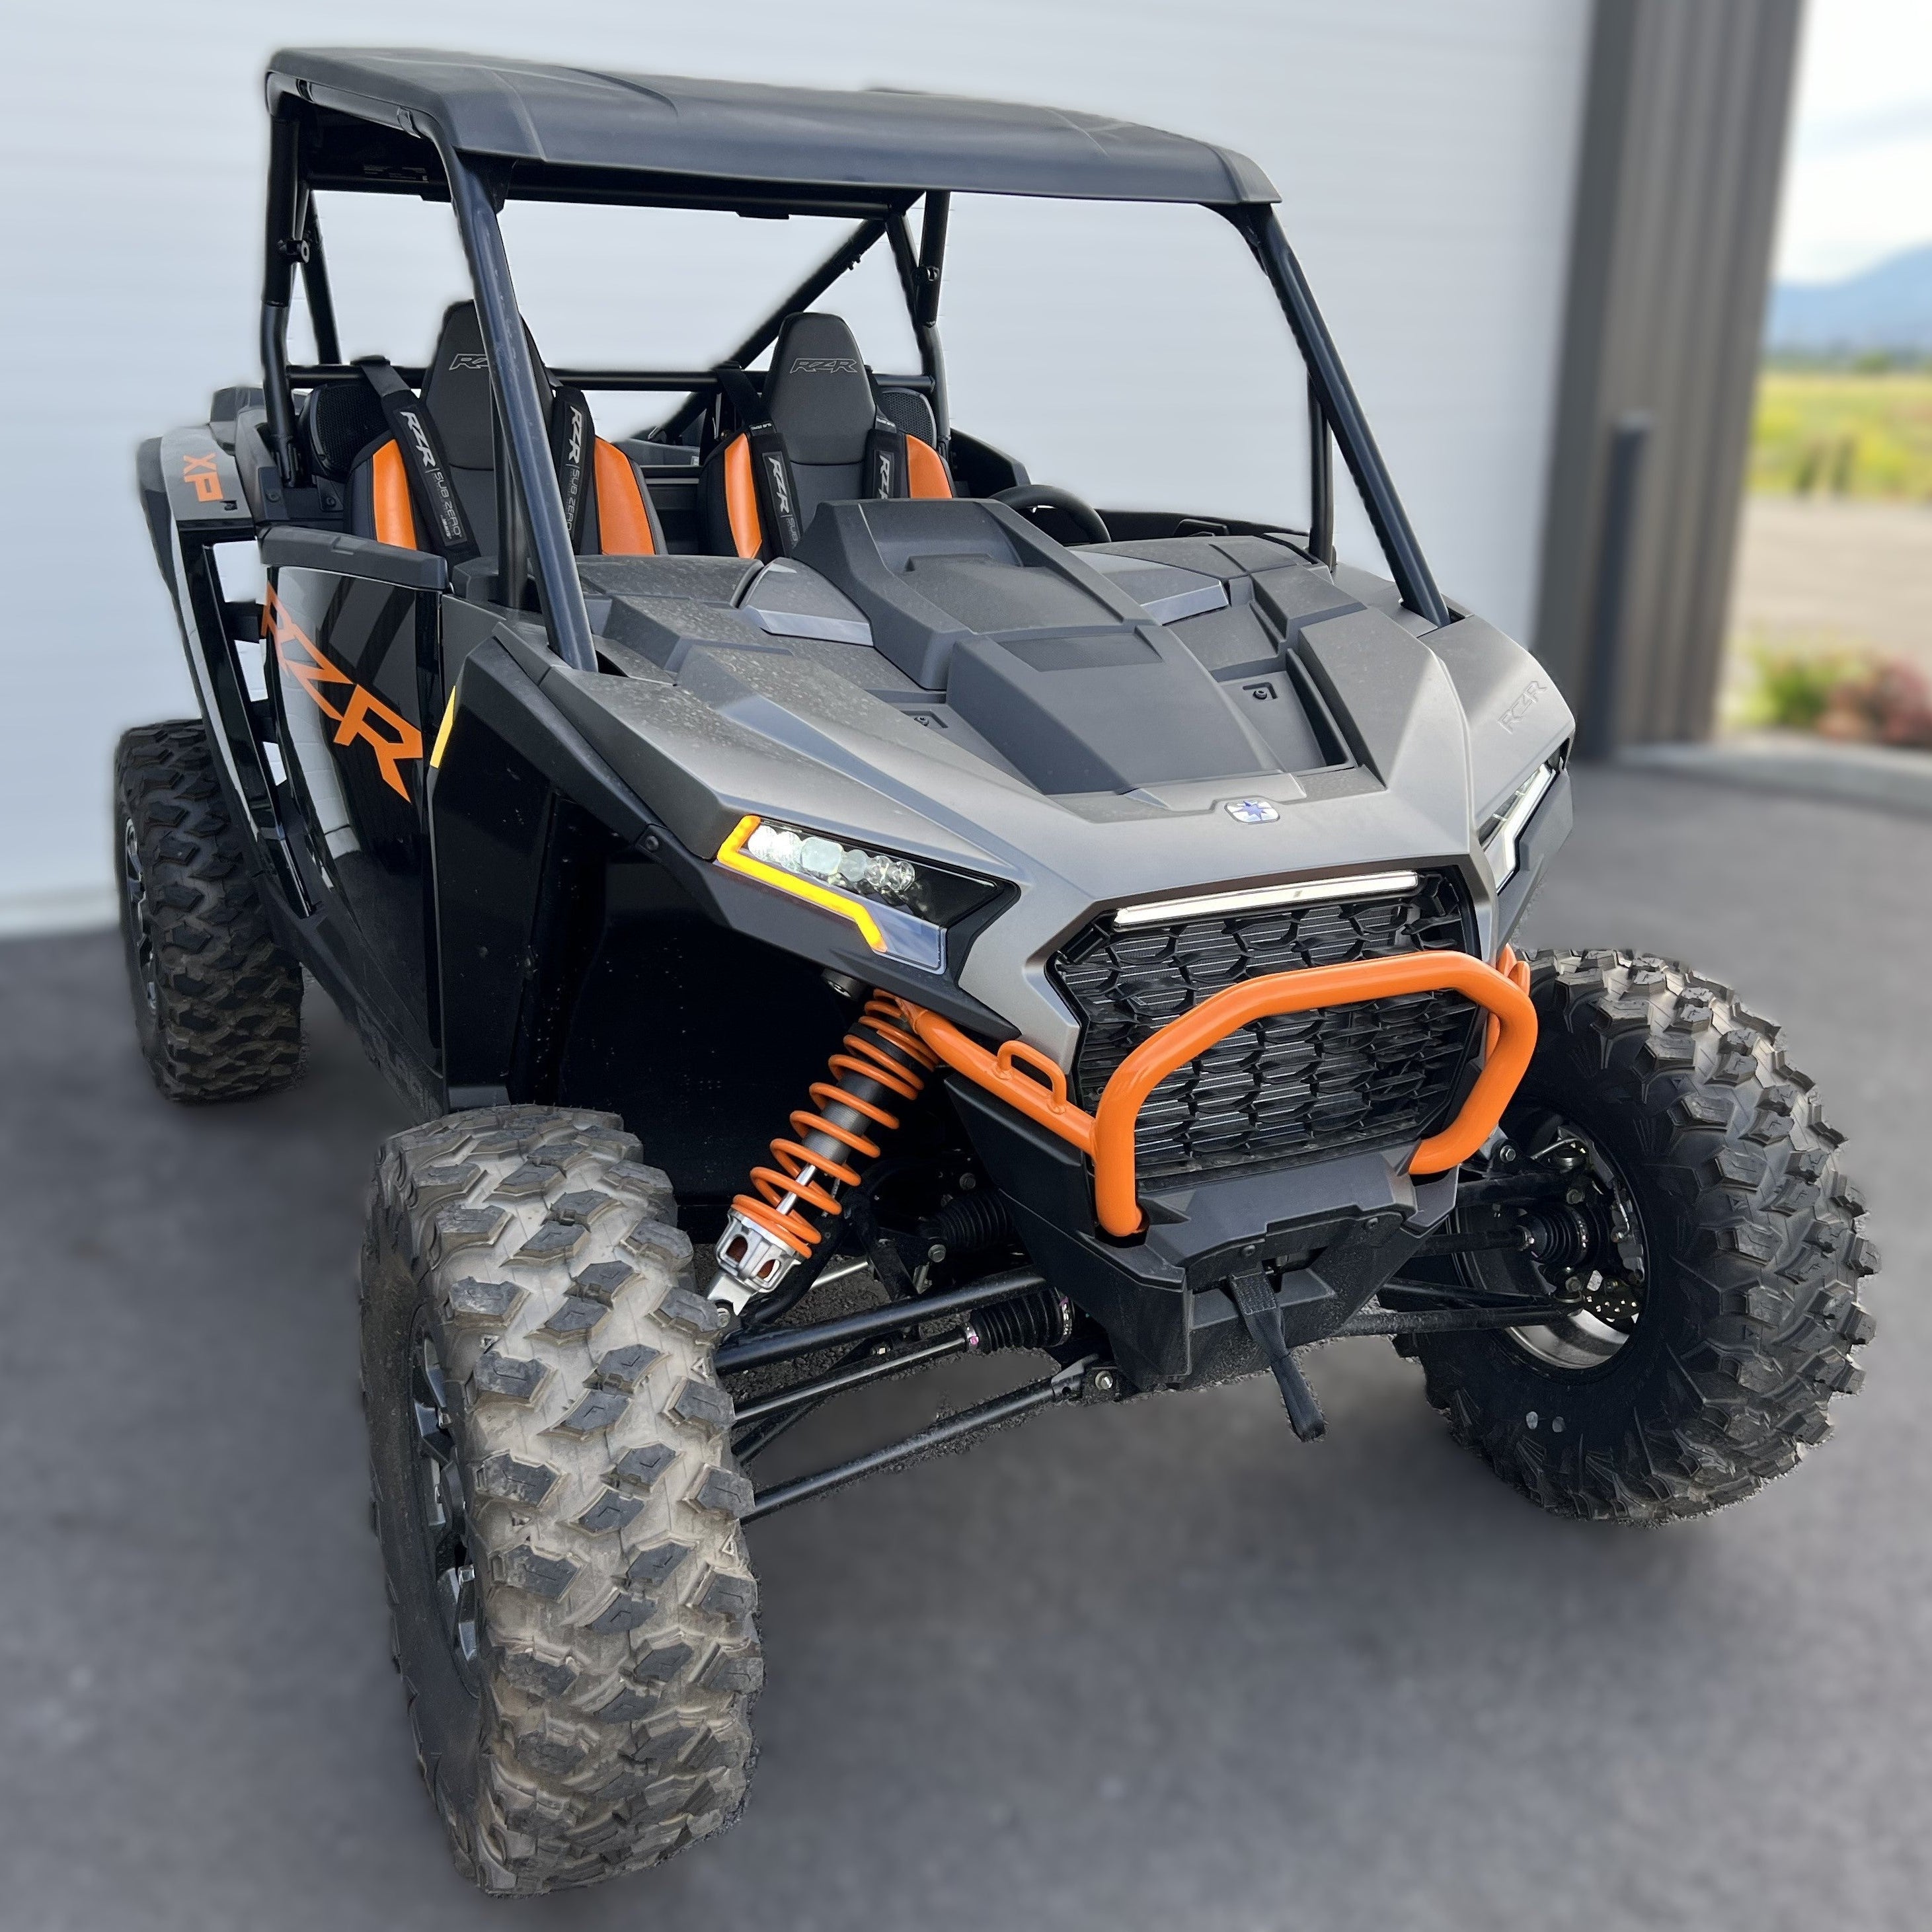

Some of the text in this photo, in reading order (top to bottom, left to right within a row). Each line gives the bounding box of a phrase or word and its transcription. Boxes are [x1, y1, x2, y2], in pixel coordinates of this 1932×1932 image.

[790, 358, 857, 373] RZR
[568, 405, 582, 463] RZR
[183, 453, 223, 502] XP
[400, 411, 436, 467] RZR
[434, 471, 449, 498] SUB
[444, 500, 461, 536] ZERO
[570, 469, 580, 495] SUB
[768, 457, 798, 541] RZR SUB
[261, 581, 423, 803] RZR
[1497, 681, 1547, 734] RZR
